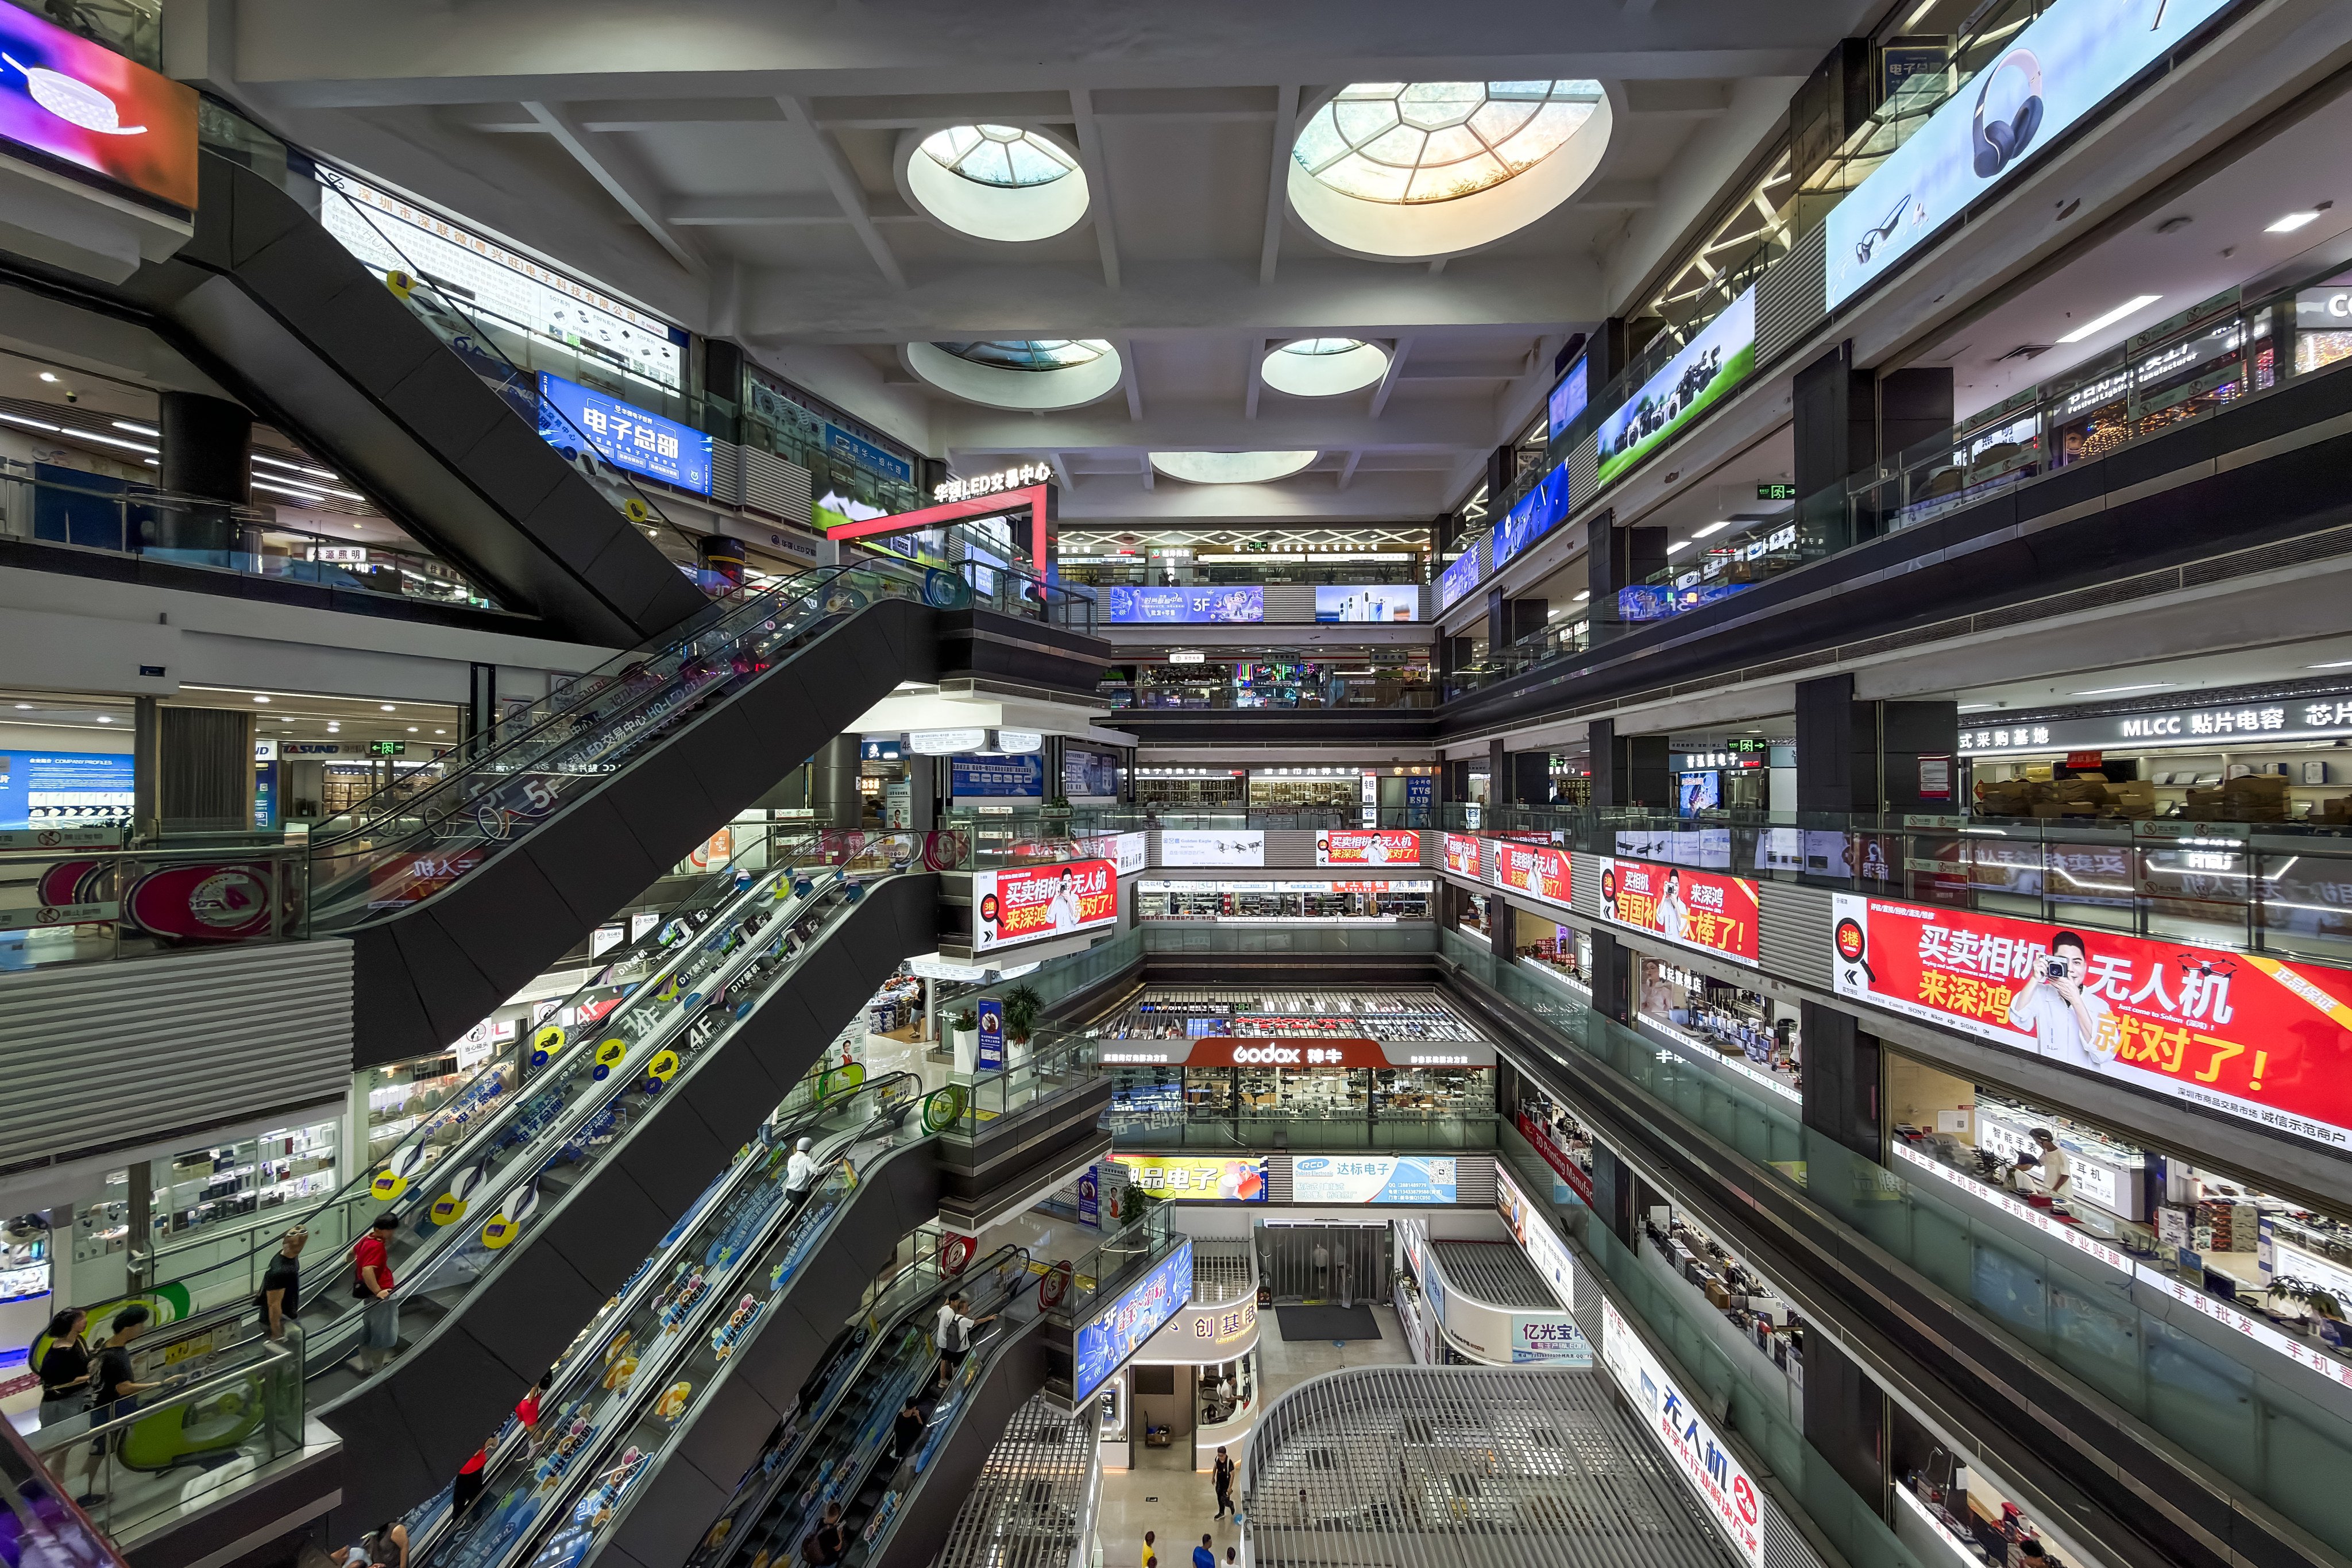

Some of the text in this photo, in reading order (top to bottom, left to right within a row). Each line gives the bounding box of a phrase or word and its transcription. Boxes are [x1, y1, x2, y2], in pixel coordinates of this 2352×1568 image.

[357, 186, 636, 323] 深圳市深联微(粤兴旺)电子科技有限公司
[549, 294, 570, 308] SOT系列
[2068, 393, 2100, 414] Festival
[584, 407, 679, 459] 电子总部
[934, 462, 1052, 503] 华强LED交易中心
[1192, 598, 1210, 612] 3F
[2123, 717, 2181, 736] MLCC
[2191, 709, 2284, 733] 贴片电容
[1959, 727, 2049, 749] 式采购基地
[523, 779, 560, 809] 5F
[1409, 796, 1429, 804] ESD
[1411, 787, 1431, 795] TVS
[1331, 836, 1412, 847] 买卖相机 无人机
[1331, 849, 1362, 859] 来深鸿
[1538, 856, 1558, 875] 无人机
[1005, 871, 1107, 905] 买卖相机 无人机
[1604, 876, 1613, 891] 3楼
[1624, 871, 1724, 909] 买相机 来深鸿
[984, 902, 994, 912] 3楼
[1005, 903, 1048, 931] 来深鸿
[1617, 890, 1658, 929] 有国补
[1871, 903, 1935, 920] 评估/置换/回收/清洗/维修
[1842, 930, 1859, 948] 3楼
[618, 948, 648, 976] DIY装机
[678, 956, 709, 985] DIY装机
[902, 961, 912, 971] 3F
[991, 970, 999, 980] 3F
[1918, 924, 2233, 1024] 买卖相机 无人机
[1945, 964, 1959, 974] selling
[1959, 967, 1979, 976] cameras
[1988, 973, 2006, 983] drones
[731, 963, 760, 994] DIY装机
[2272, 967, 2341, 1013] 正品保证
[576, 994, 603, 1025] 4F
[1918, 969, 2012, 1025] 来深鸿
[1888, 1001, 1904, 1010] Canon
[1908, 1007, 1927, 1017] SONY
[1930, 1013, 1943, 1021] Nikon
[1960, 1021, 1978, 1032] SIGMA
[2118, 1003, 2183, 1024] Just come to Sohon
[689, 1014, 713, 1049] 4F
[1233, 1041, 1301, 1063] Godox
[1535, 1133, 1543, 1149] 3D
[1544, 1141, 1565, 1175] Printing
[1992, 1126, 2044, 1154] 智能手表
[1337, 1163, 1389, 1176] 达标电子
[1899, 1145, 2121, 1268] 精品二手 手机配件 手机维修 专业贴膜
[1104, 1305, 1118, 1333] 3F
[1604, 1300, 1626, 1335] AUTEL
[2173, 1283, 2254, 1337] 手机批发
[1663, 1384, 1728, 1494] 无人机
[1662, 1415, 1757, 1556] 数字化行业解决方案
